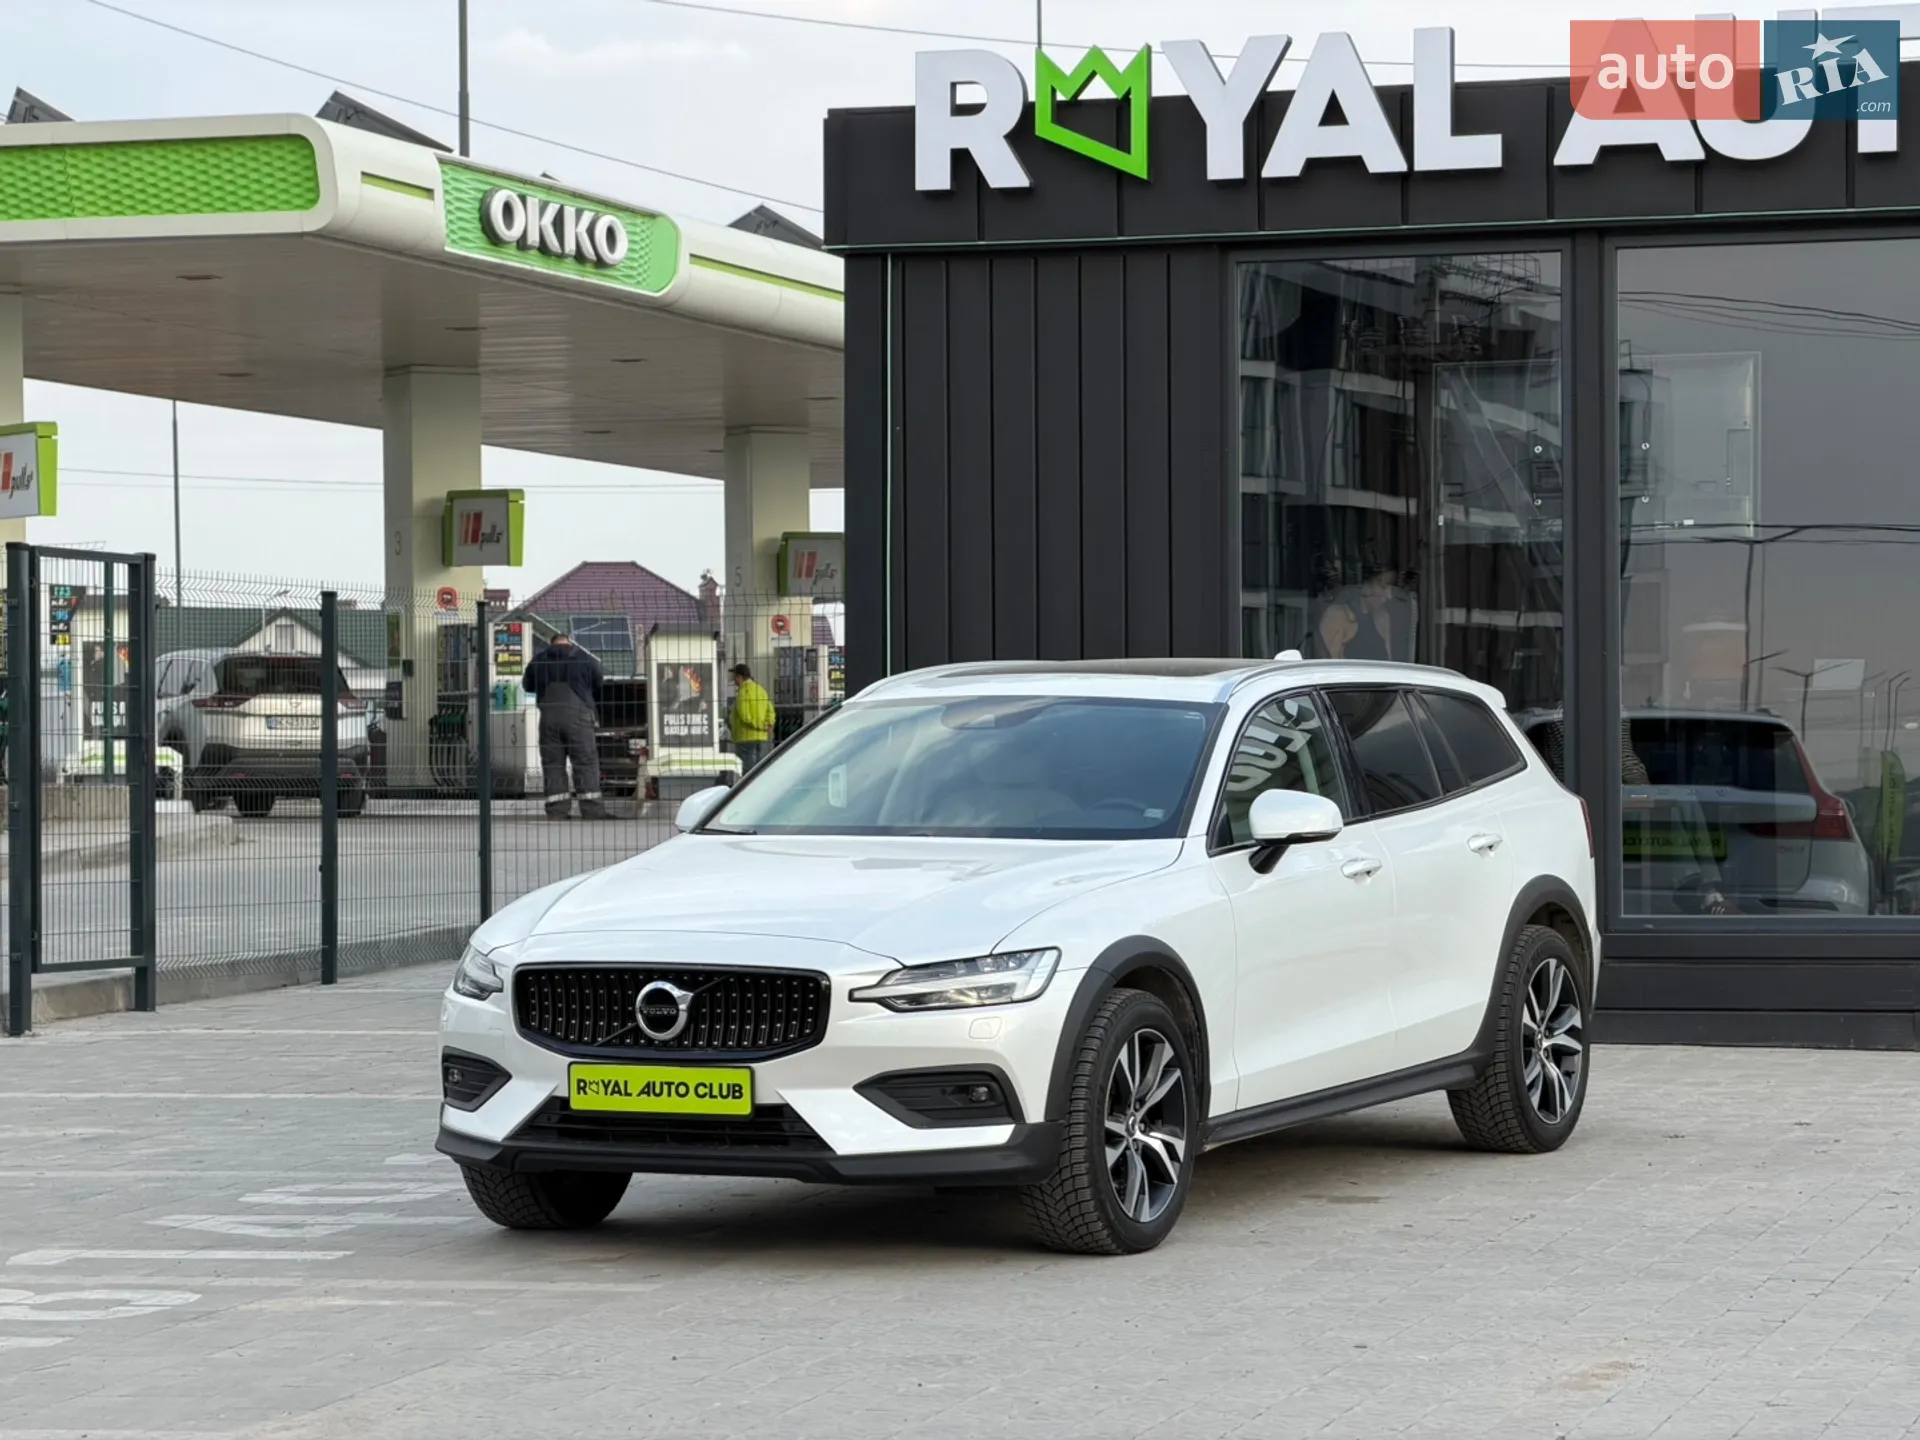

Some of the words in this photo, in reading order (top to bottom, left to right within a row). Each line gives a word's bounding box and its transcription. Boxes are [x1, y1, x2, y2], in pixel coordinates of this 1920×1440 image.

[484, 187, 628, 267] OKKO
[734, 566, 743, 588] 5
[641, 1006, 677, 1016] VOLVO
[636, 1080, 690, 1098] AUTO
[693, 1081, 744, 1100] CLUB
